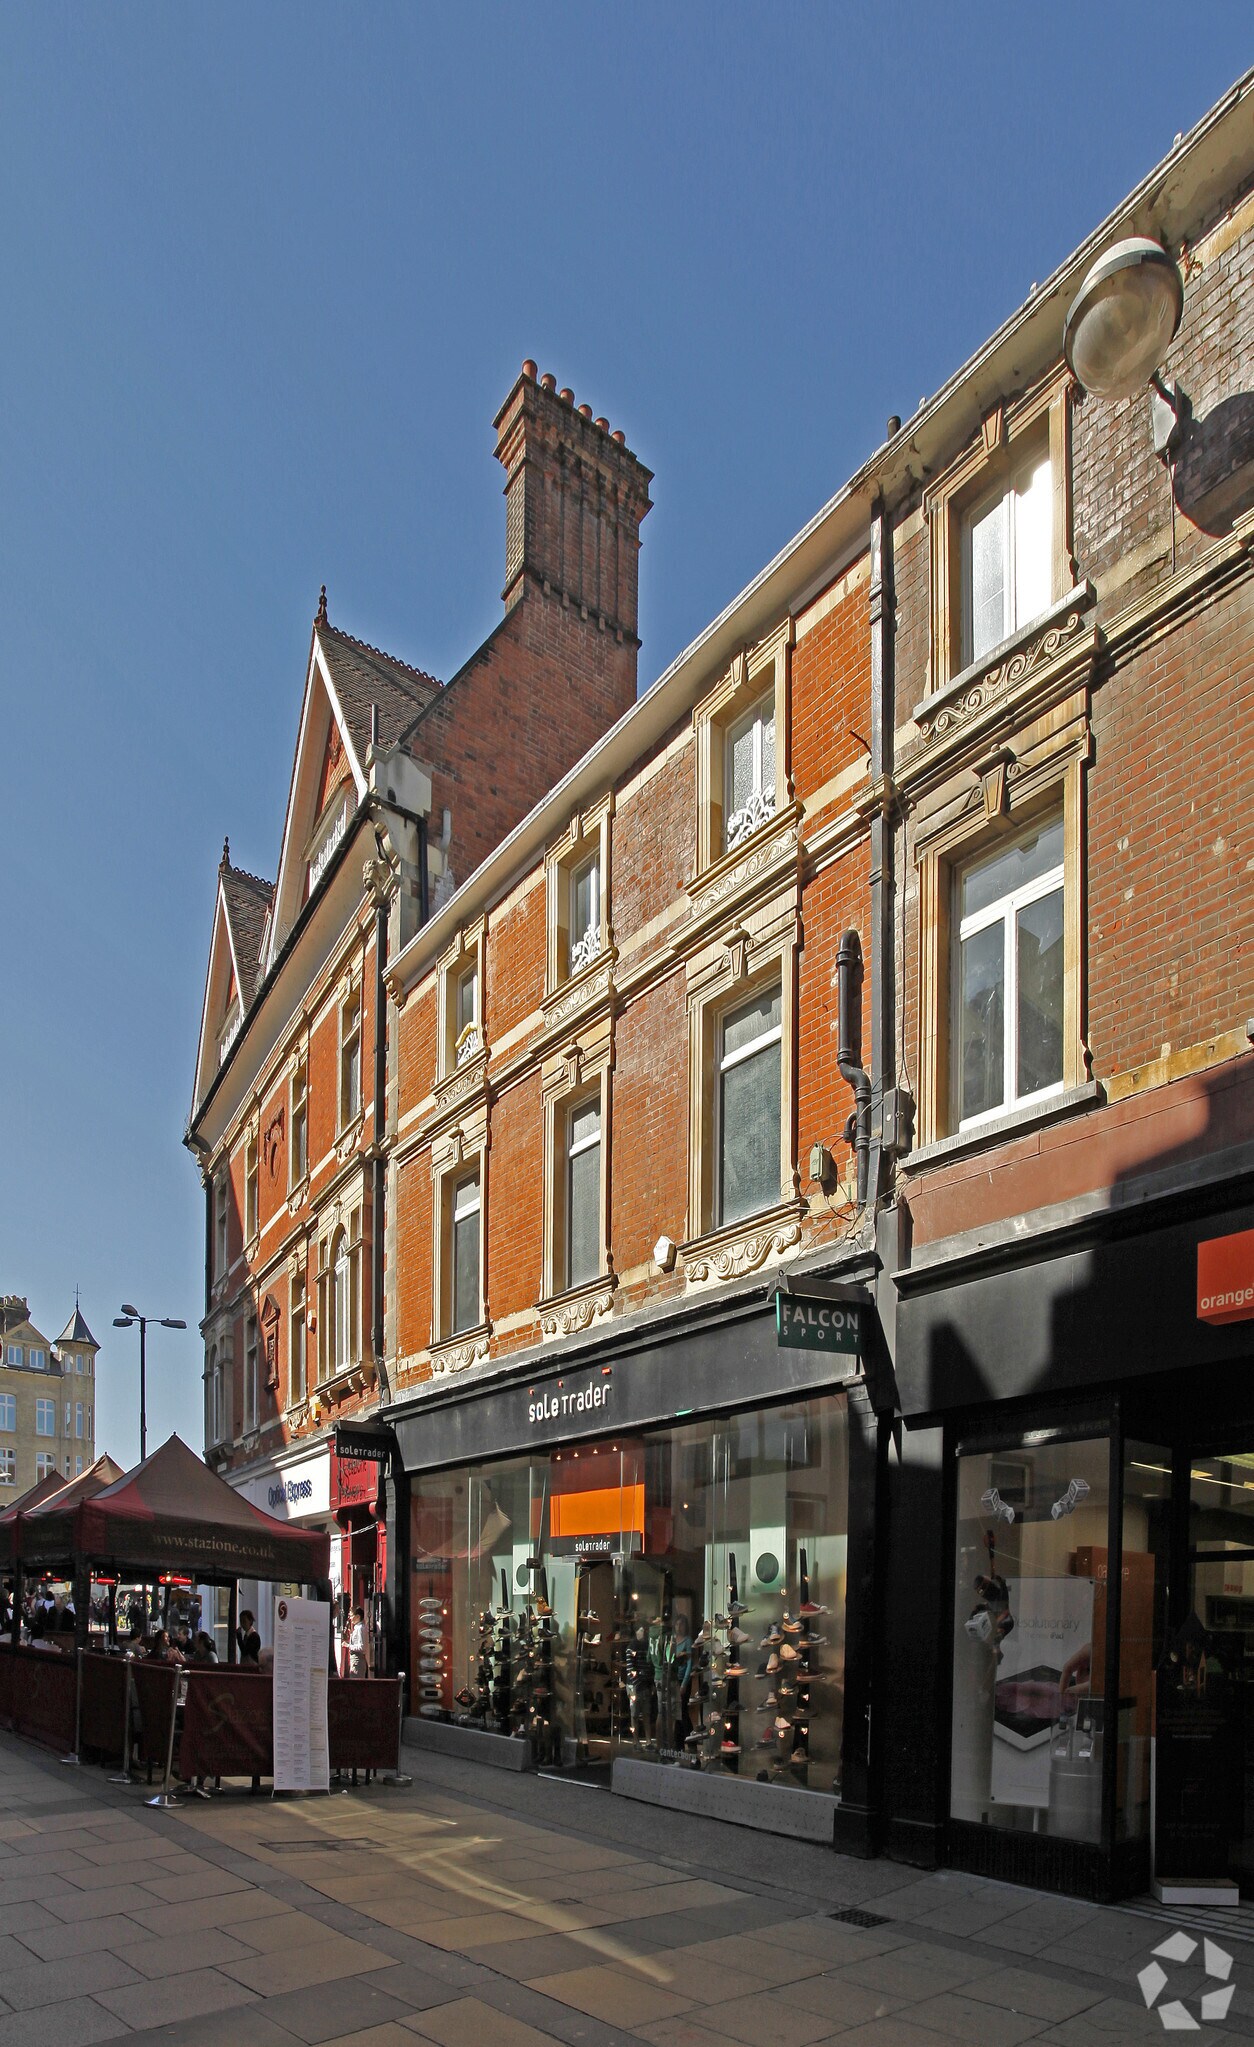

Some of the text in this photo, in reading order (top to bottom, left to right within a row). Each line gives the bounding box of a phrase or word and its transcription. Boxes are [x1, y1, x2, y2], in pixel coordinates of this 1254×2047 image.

[1200, 1288, 1254, 1310] orange
[782, 1304, 859, 1330] FALCON
[783, 1325, 859, 1343] SPORT
[287, 1479, 313, 1506] Express
[152, 1535, 276, 1559] www.stazione.co.uk
